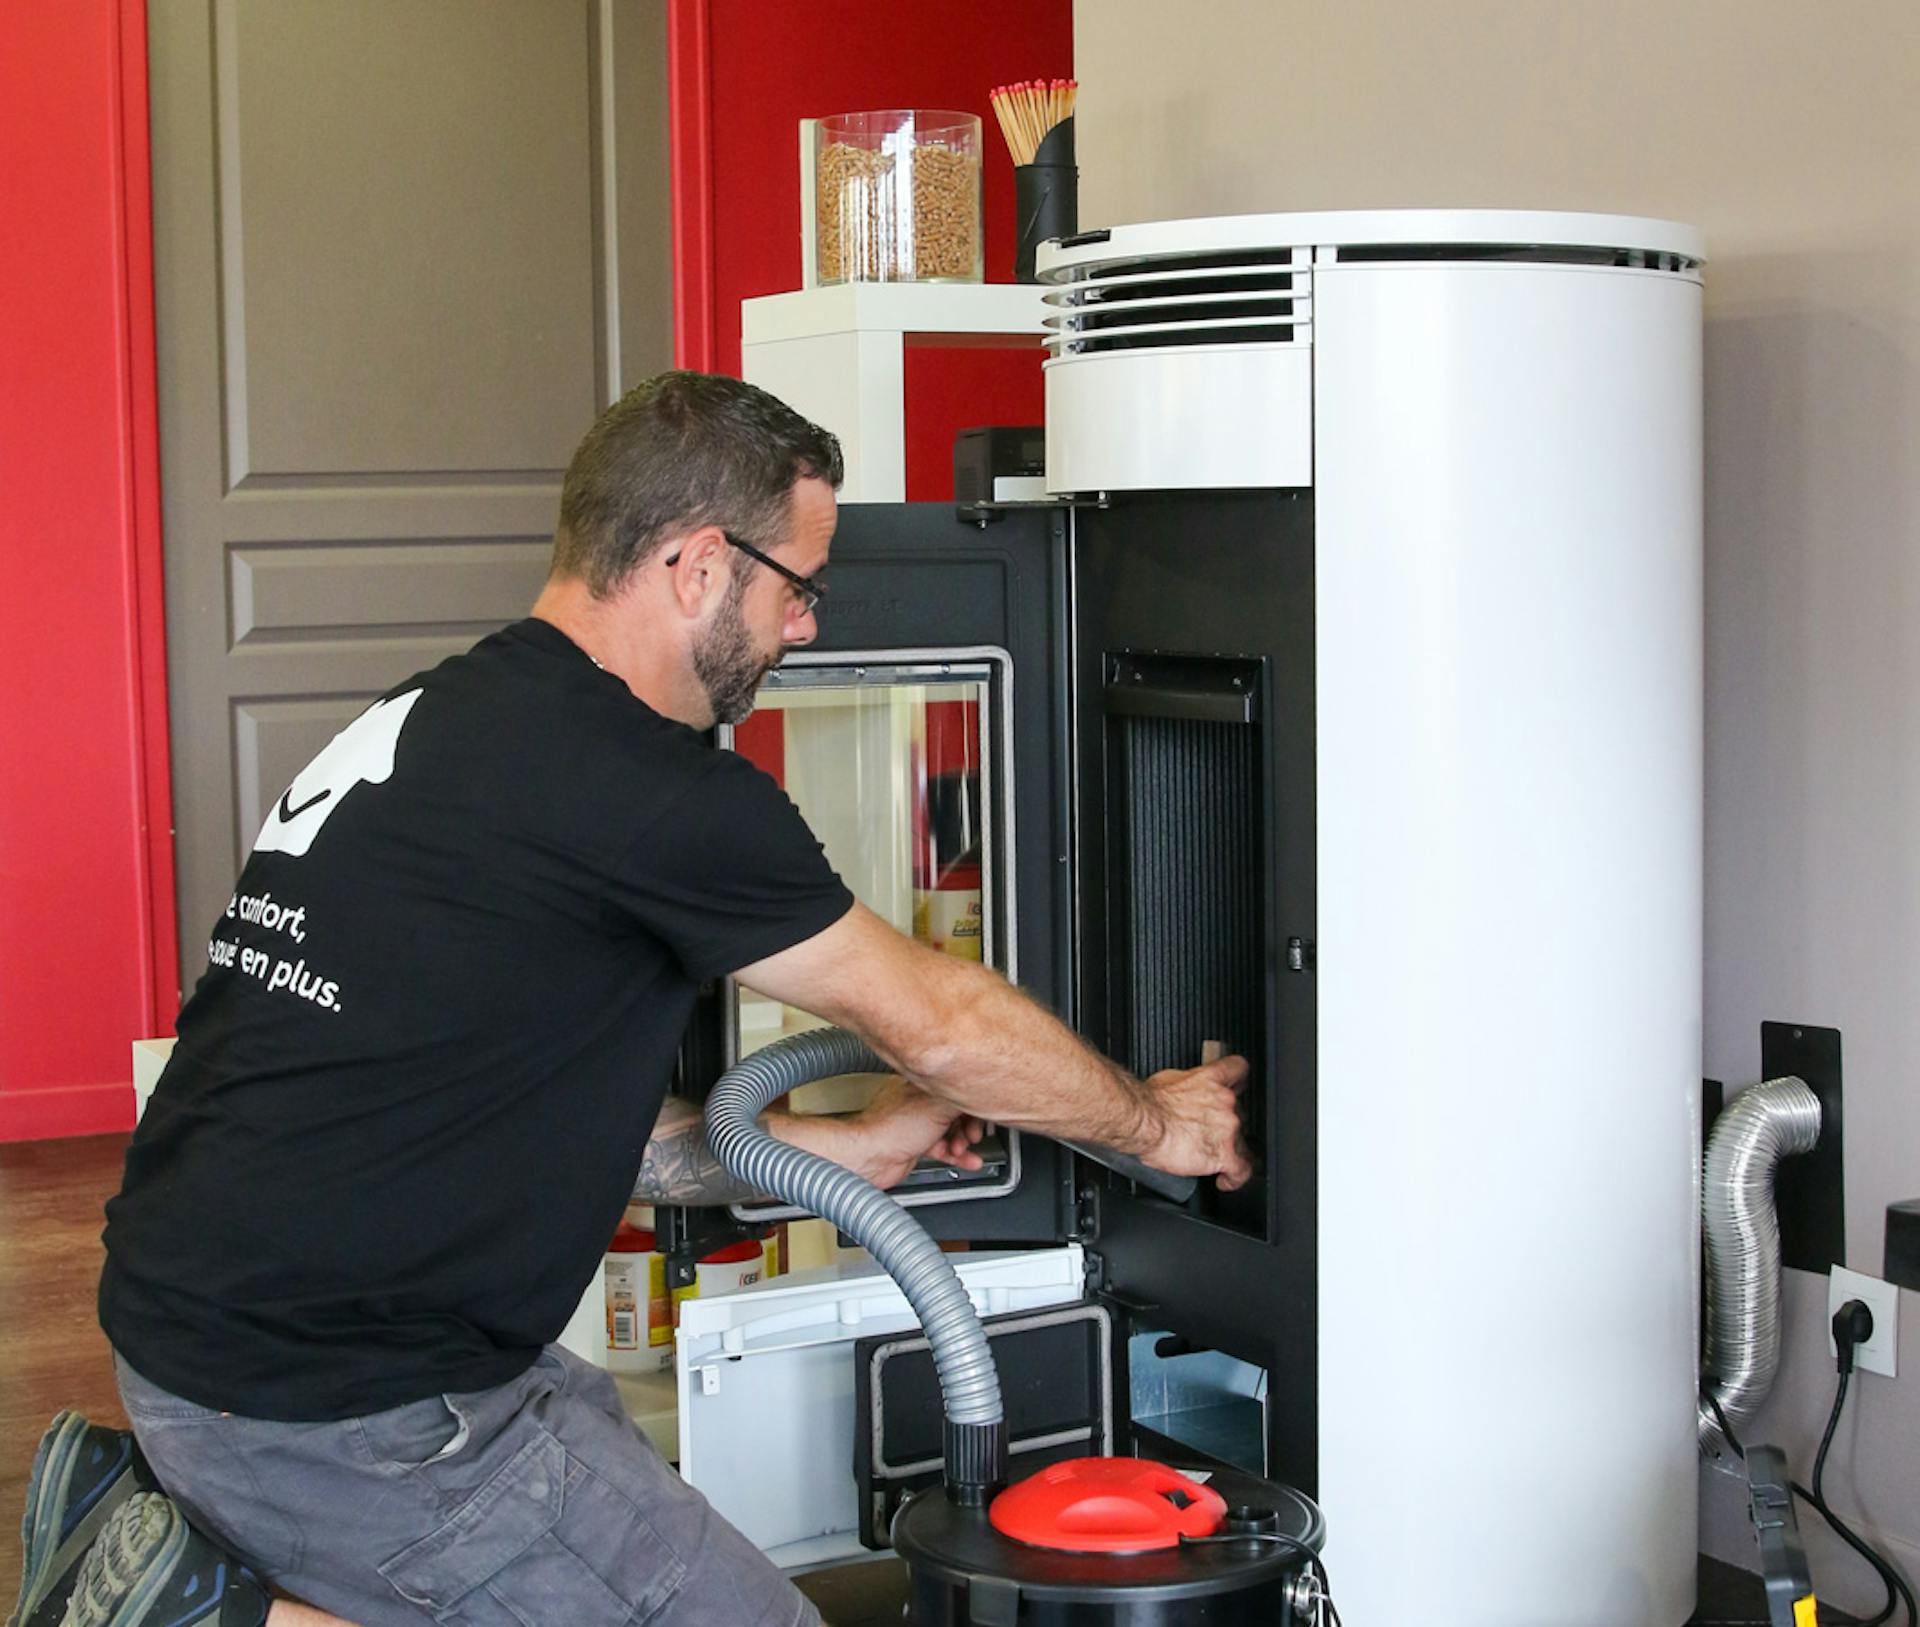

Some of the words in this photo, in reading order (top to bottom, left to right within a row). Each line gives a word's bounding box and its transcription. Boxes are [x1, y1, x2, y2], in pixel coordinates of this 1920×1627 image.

[239, 893, 306, 944] confort,
[240, 947, 270, 979] en
[267, 959, 342, 1012] plus.
